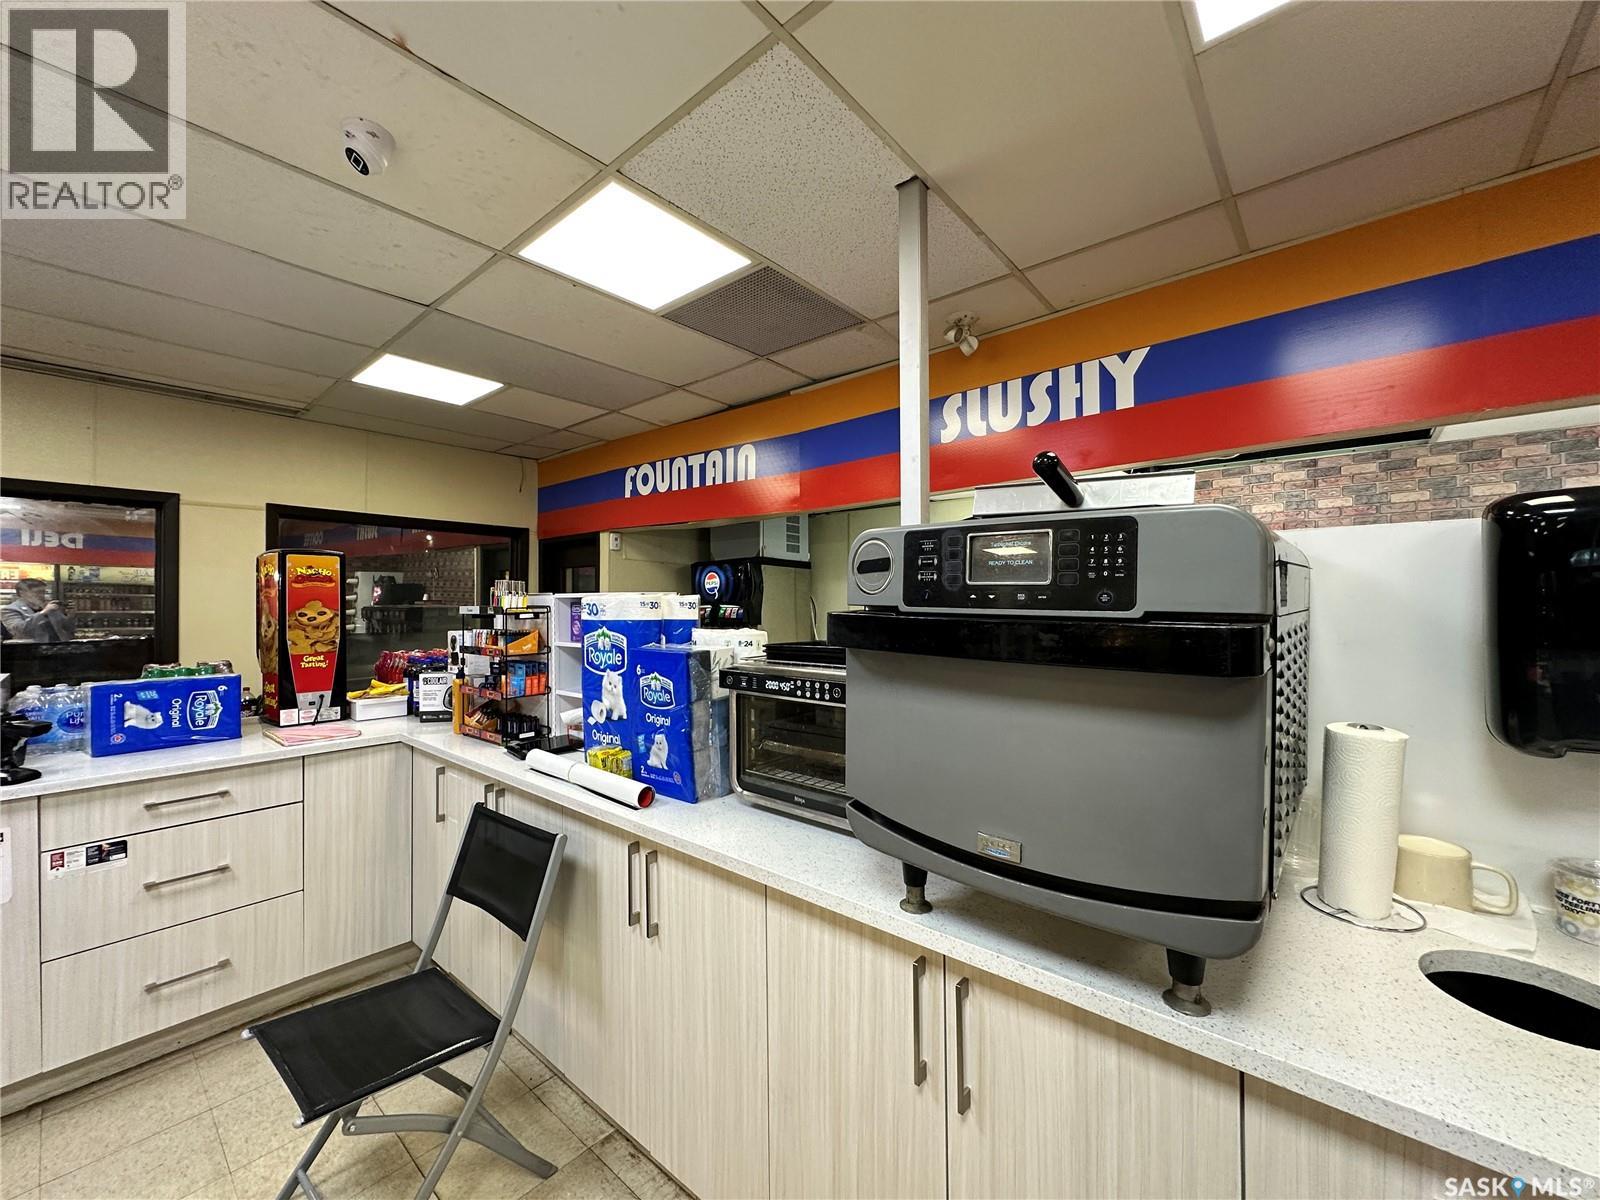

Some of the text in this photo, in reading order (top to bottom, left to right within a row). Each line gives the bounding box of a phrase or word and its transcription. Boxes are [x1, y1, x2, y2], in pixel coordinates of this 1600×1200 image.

[940, 346, 1151, 444] SLUSHY
[623, 443, 756, 499] FOUNTAIN
[300, 660, 329, 669] Tasting!
[303, 654, 325, 663] Great
[588, 647, 623, 669] Royale
[636, 664, 642, 676] 6
[643, 687, 671, 704] Royale
[168, 698, 182, 728] Original
[190, 694, 208, 726] Royale
[645, 712, 671, 727] Original
[591, 728, 621, 746] Original
